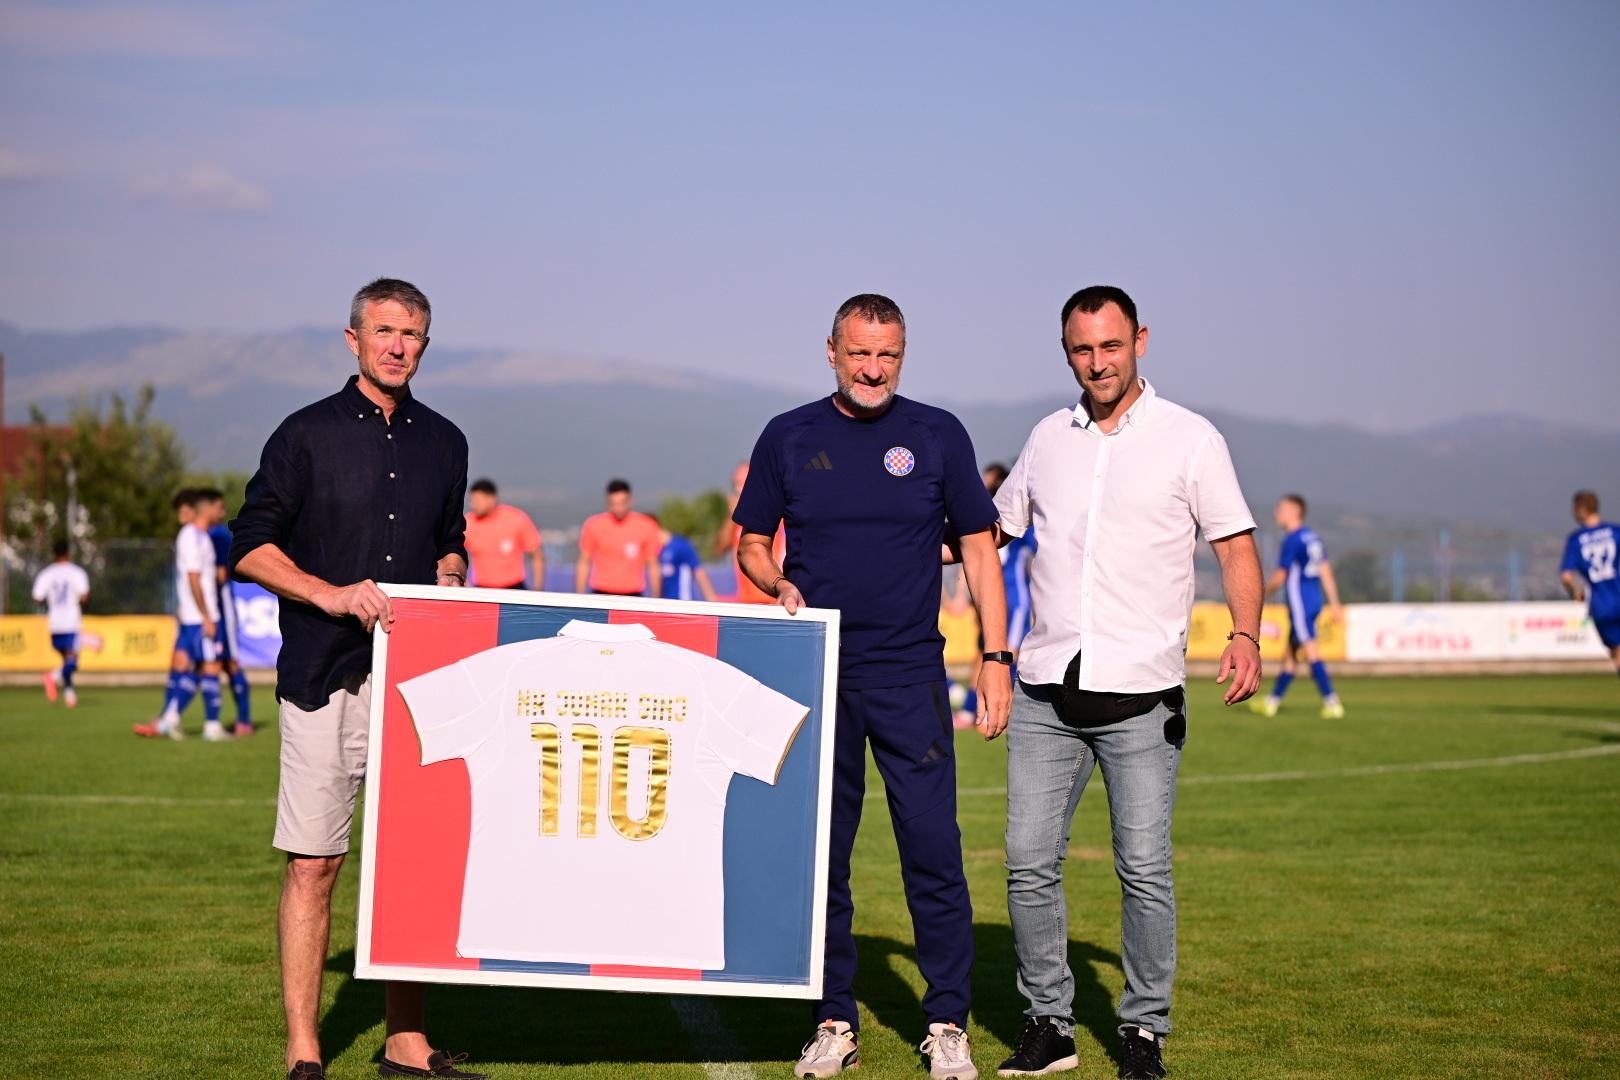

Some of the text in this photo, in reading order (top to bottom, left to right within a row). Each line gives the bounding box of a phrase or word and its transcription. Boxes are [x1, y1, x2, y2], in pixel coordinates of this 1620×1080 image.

[517, 688, 689, 722] NK JUNAK SINJ
[530, 722, 673, 842] 110
